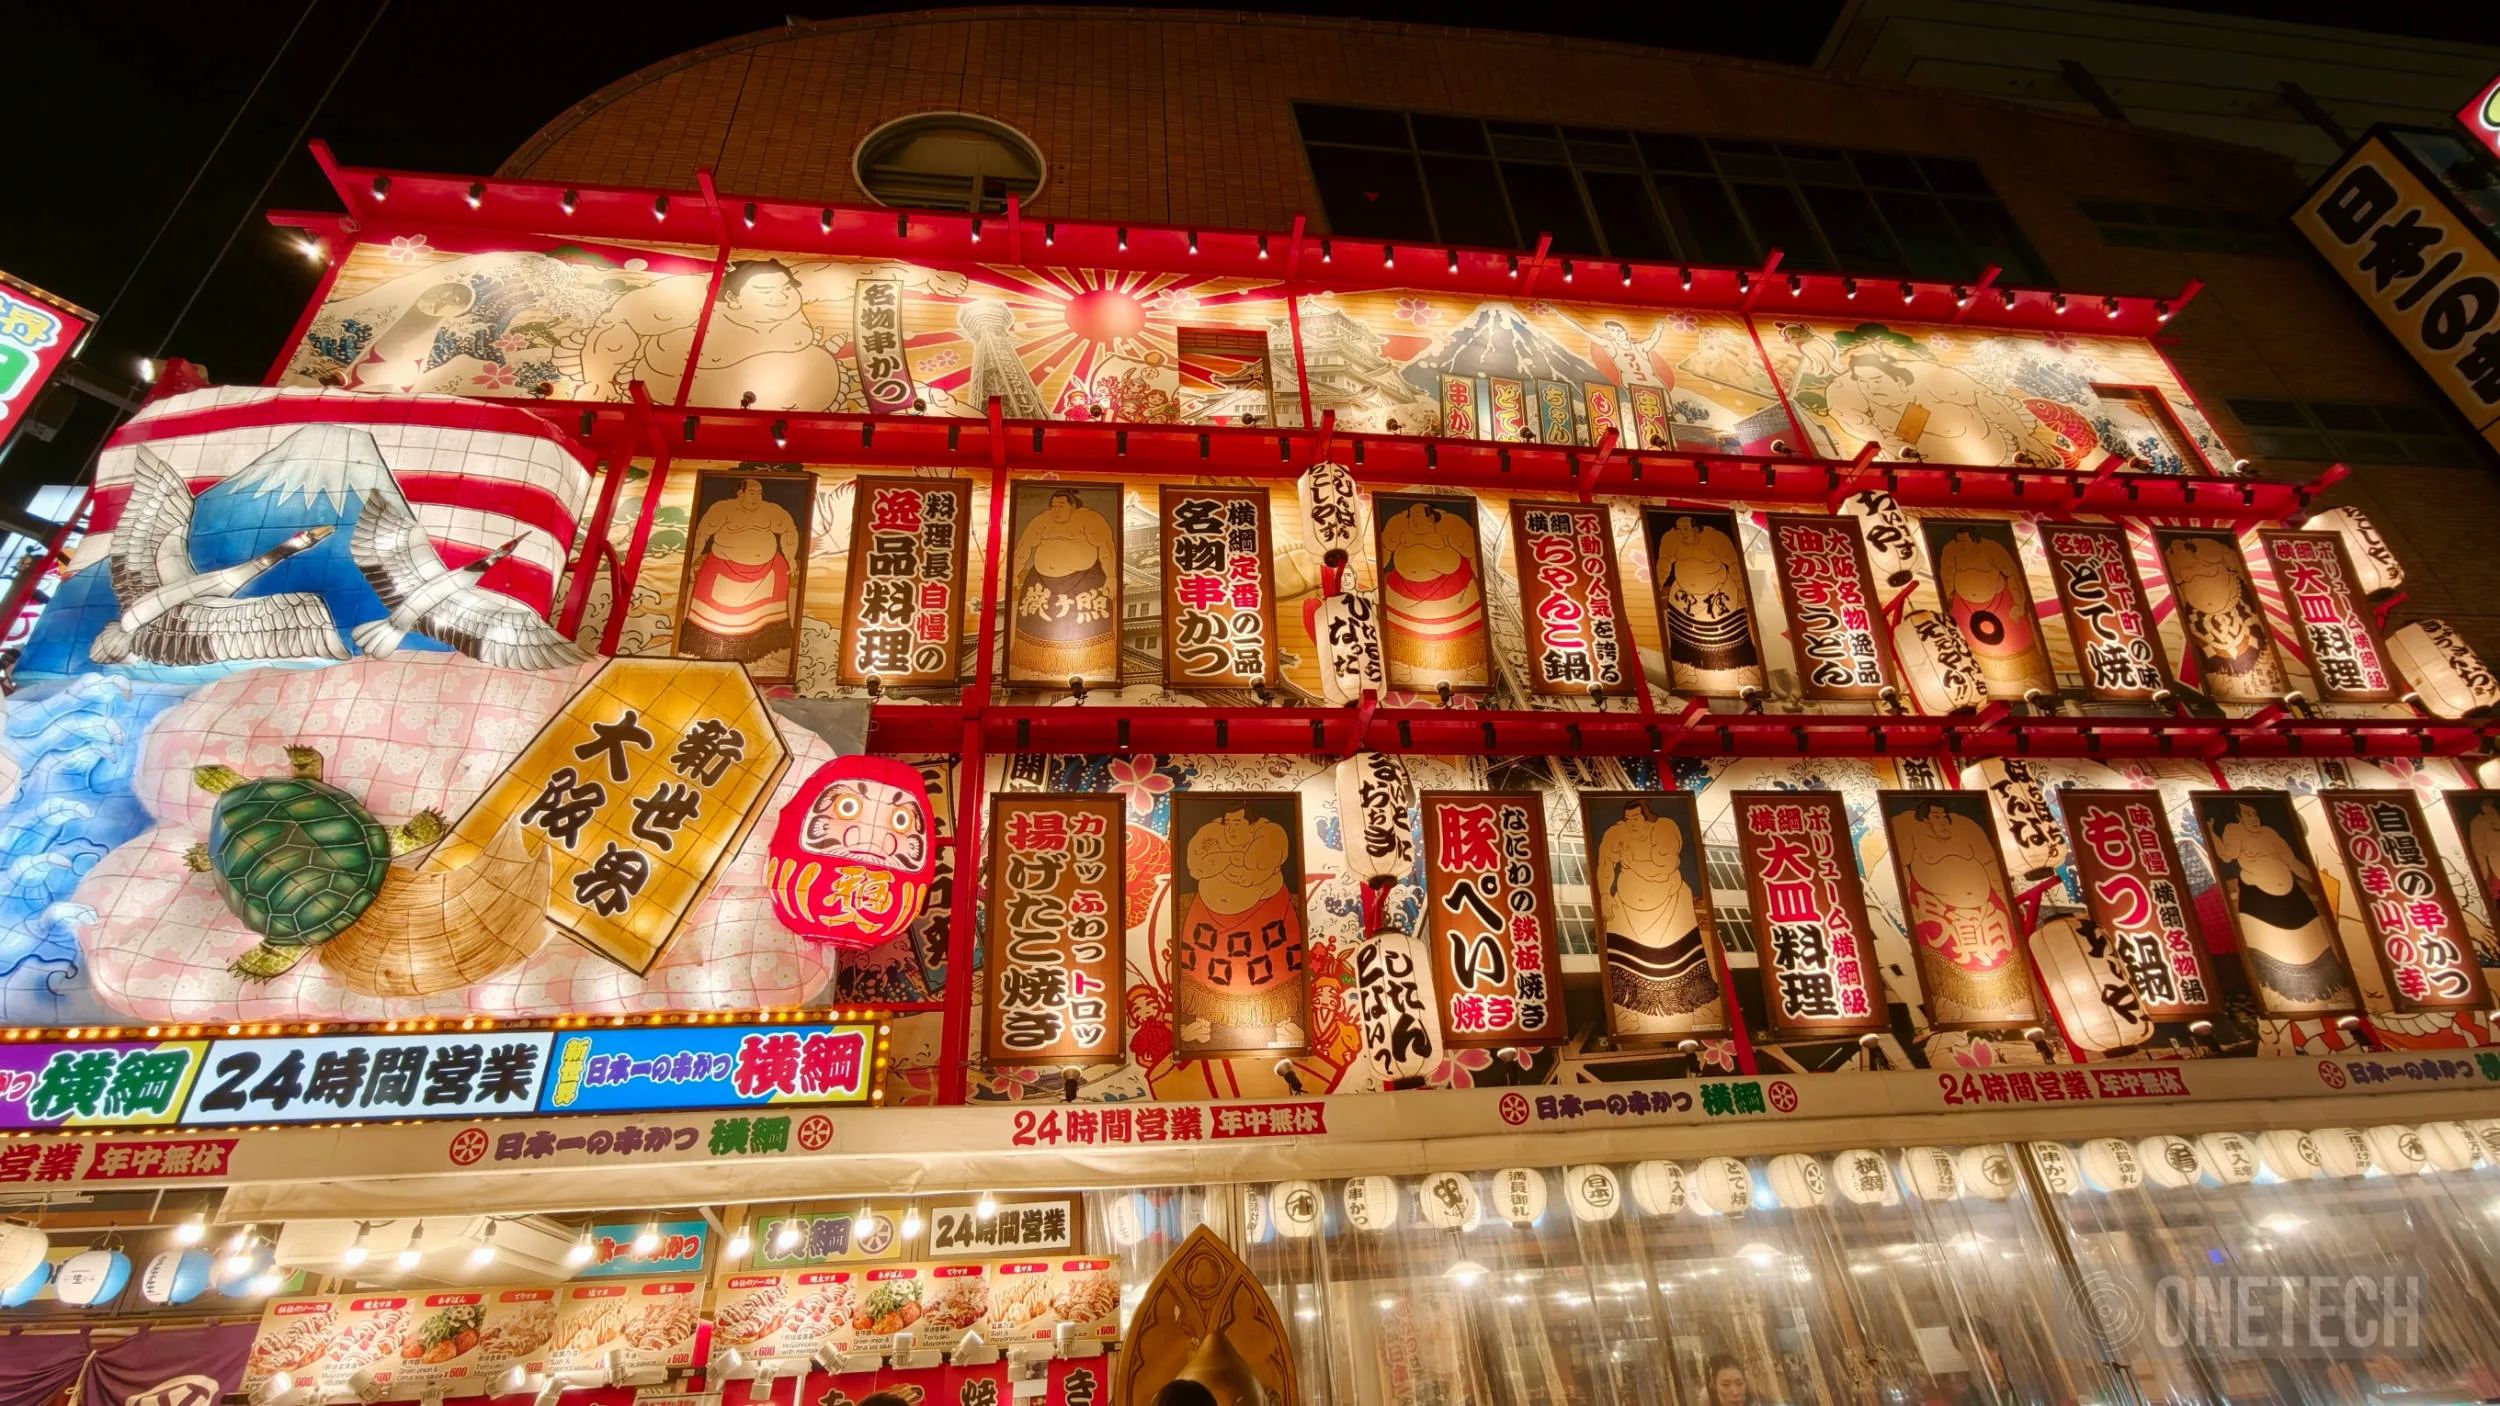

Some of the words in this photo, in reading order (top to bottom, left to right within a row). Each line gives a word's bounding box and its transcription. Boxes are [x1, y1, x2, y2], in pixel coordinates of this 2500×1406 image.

[861, 282, 909, 406] 名物串かつ
[1448, 381, 1472, 439] 串か
[1545, 386, 1570, 443] ちゃん
[1592, 392, 1619, 447] もつ
[1639, 391, 1665, 450] 串か
[1525, 512, 1573, 535] 横綱
[2053, 534, 2097, 557] 名物
[2275, 539, 2316, 560] 横綱
[857, 488, 923, 674] 逸品料理
[913, 491, 957, 673] 料理長自慢の
[1171, 499, 1229, 675] 名物串かつ
[1226, 500, 1264, 675] 横綱定番の一品
[1530, 536, 1593, 682] ちゃんこ鍋
[1575, 515, 1621, 684] 不動の人気を誇る
[1784, 526, 1854, 688] 油かすうどん
[1828, 531, 1881, 686] 大阪名物逸品
[2097, 539, 2161, 689] 大阪下町の味
[2316, 540, 2388, 689] ボリューム横綱級
[2062, 557, 2136, 691] どて焼
[2288, 558, 2369, 691] 大皿料理
[521, 710, 653, 849] 大阪
[572, 718, 746, 920] 新世界
[1071, 814, 1106, 880] カリッ
[1749, 804, 1805, 835] 横綱
[1000, 809, 1070, 1051] 揚げたこ焼き
[1071, 891, 1106, 963] ふわっ
[1500, 804, 1548, 1031] なにわの鉄板焼き
[1758, 835, 1841, 1020] 大皿料理
[1804, 805, 1871, 1019] ボリューム横綱級
[2080, 807, 2174, 1006] もつ鍋
[2128, 803, 2171, 876] 味自慢
[2152, 879, 2207, 1004] 横綱名物鍋
[2334, 801, 2395, 897] 海の幸
[2371, 902, 2431, 1001] 山の幸
[2371, 801, 2471, 999] 自慢の串かつ
[1071, 968, 1106, 1048] トロッ
[30, 1048, 189, 1120] 横綱
[200, 1043, 539, 1112] 24時間営業
[552, 1037, 590, 1108] 新世界
[585, 1052, 732, 1087] 日本一の串かつ
[732, 1031, 866, 1098] 横綱
[1536, 1091, 1692, 1120] 日本一の串かつ
[1701, 1081, 1766, 1115] 横綱
[1938, 1068, 2095, 1105] 24時間営業
[2100, 1069, 2184, 1095] 年中無休
[0, 1143, 83, 1183] 営業
[98, 1144, 227, 1177] 年中無休
[495, 1127, 699, 1163] 日本一の串かつ
[709, 1116, 792, 1156] 横綱
[1012, 1109, 1203, 1147] 24時間営業
[1217, 1105, 1319, 1135] 年中無休
[1349, 1188, 1369, 1225] 串かつ
[1509, 1170, 1530, 1216] 満員御礼
[2043, 1152, 2067, 1187] 串かつ
[578, 1235, 700, 1265] 本一かつ
[936, 1210, 1066, 1250] 24時間営業
